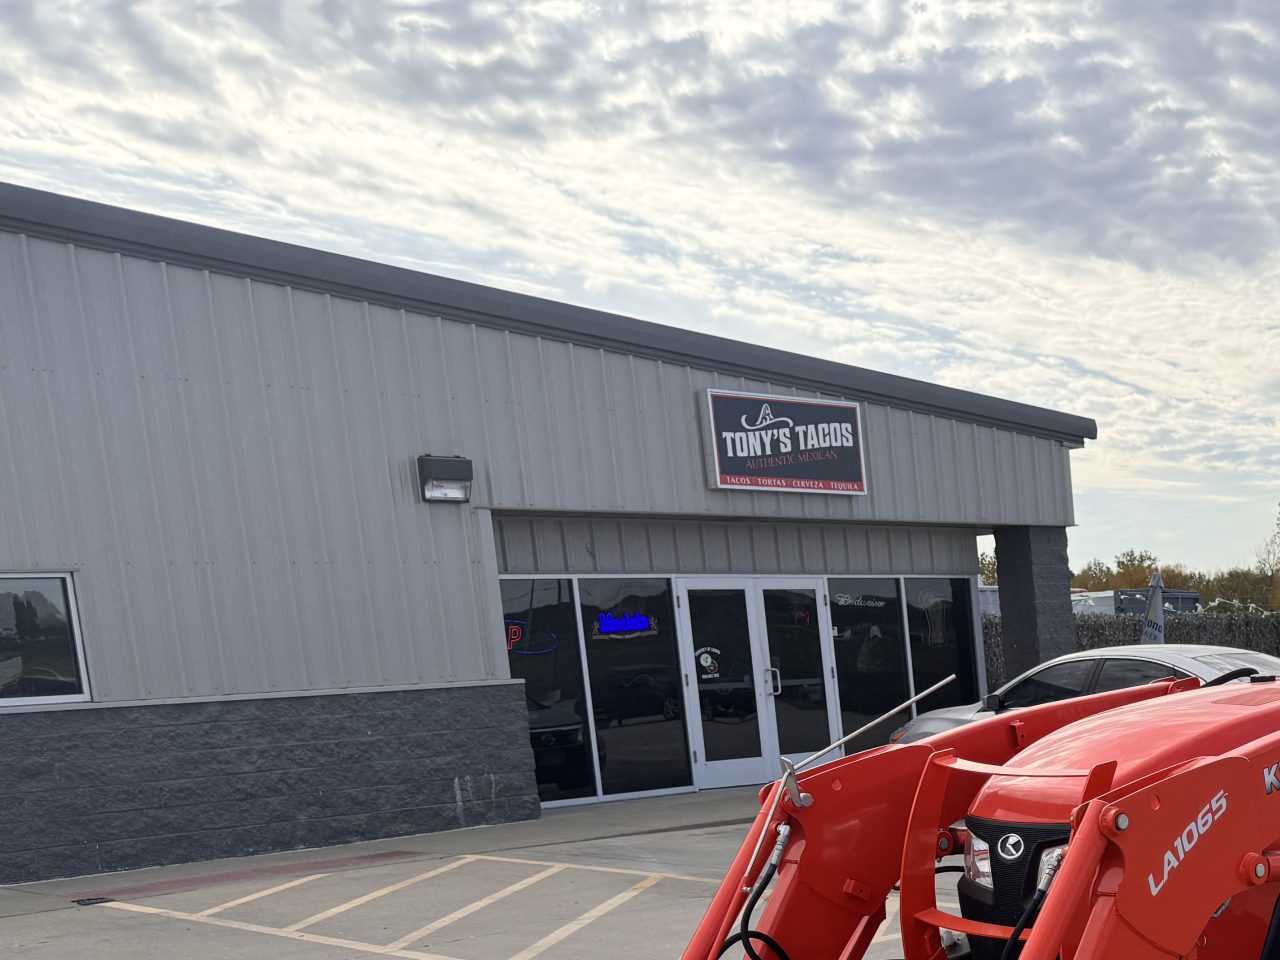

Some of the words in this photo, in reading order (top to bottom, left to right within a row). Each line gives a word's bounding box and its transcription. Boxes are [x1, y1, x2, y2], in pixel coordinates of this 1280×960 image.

[722, 427, 792, 457] TONY'S
[795, 422, 854, 450] TACOS
[745, 456, 796, 469] AUTHENTIC
[798, 450, 838, 462] MEXICAN
[726, 476, 751, 485] TACOS
[757, 478, 786, 487] TORTAS
[792, 480, 824, 489] CERVEZA
[831, 482, 859, 490] TEQUILA
[835, 593, 886, 608] Budweiser
[1147, 789, 1228, 897] LA1065
